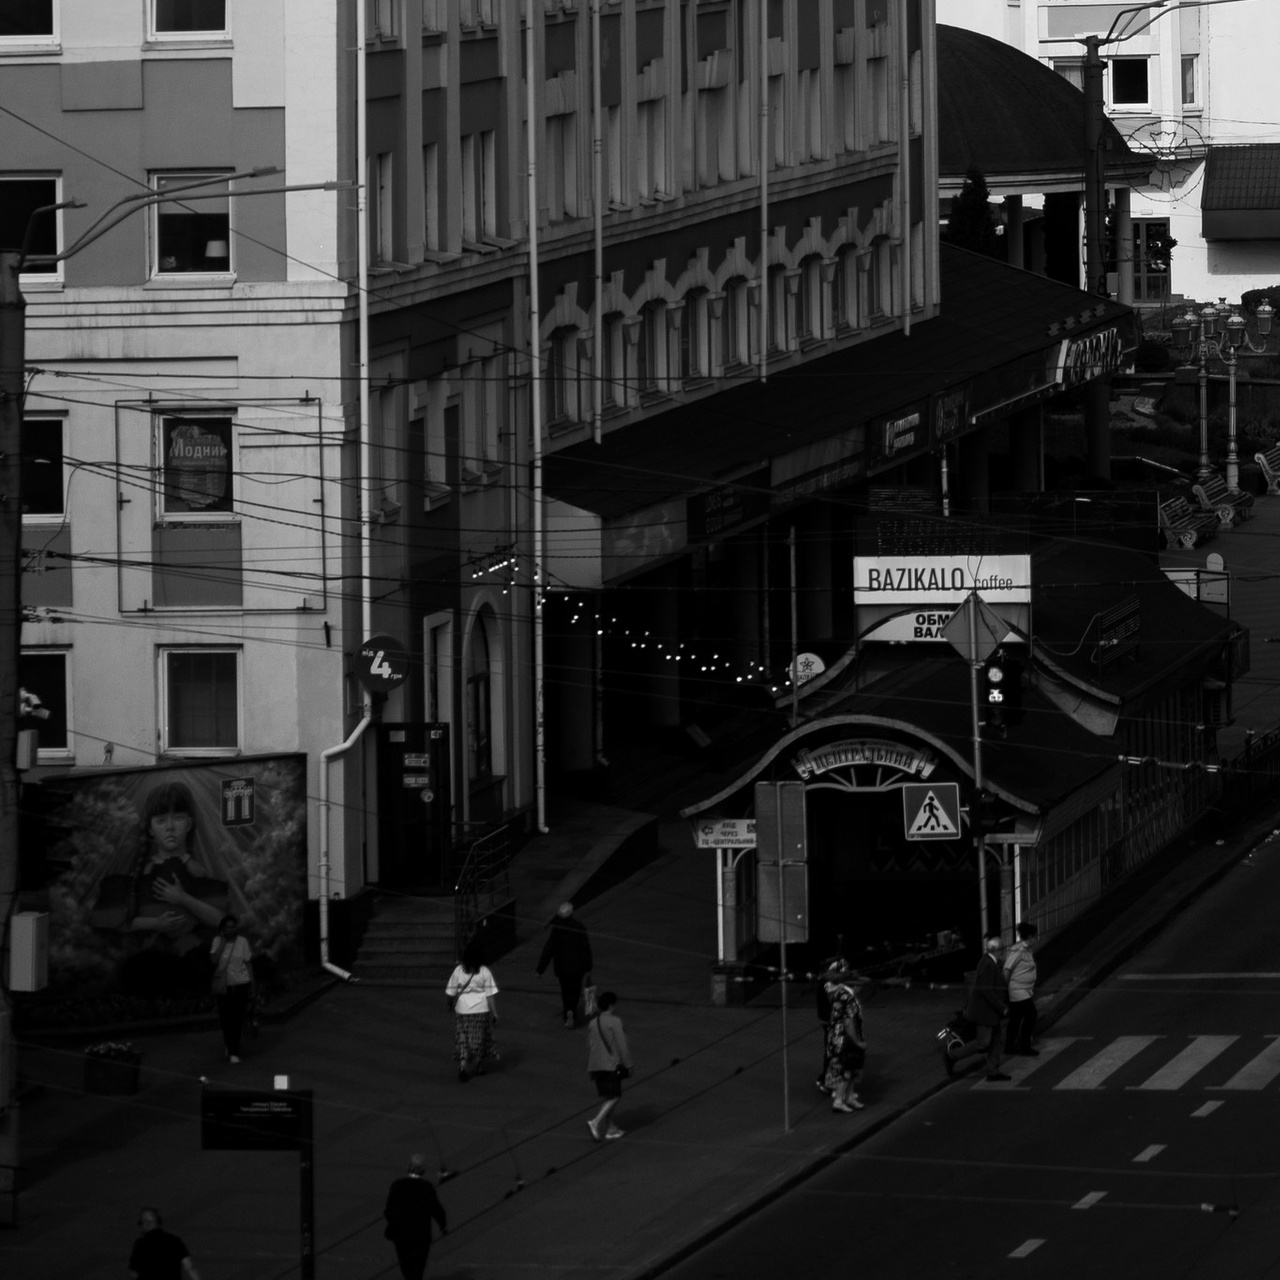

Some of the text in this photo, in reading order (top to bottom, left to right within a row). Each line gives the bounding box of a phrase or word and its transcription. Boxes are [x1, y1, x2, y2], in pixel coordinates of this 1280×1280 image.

[868, 568, 1013, 591] BAZIKALO coffee
[915, 613, 950, 626] ОБМ
[914, 626, 945, 638] ВАЛ
[370, 650, 392, 679] 4
